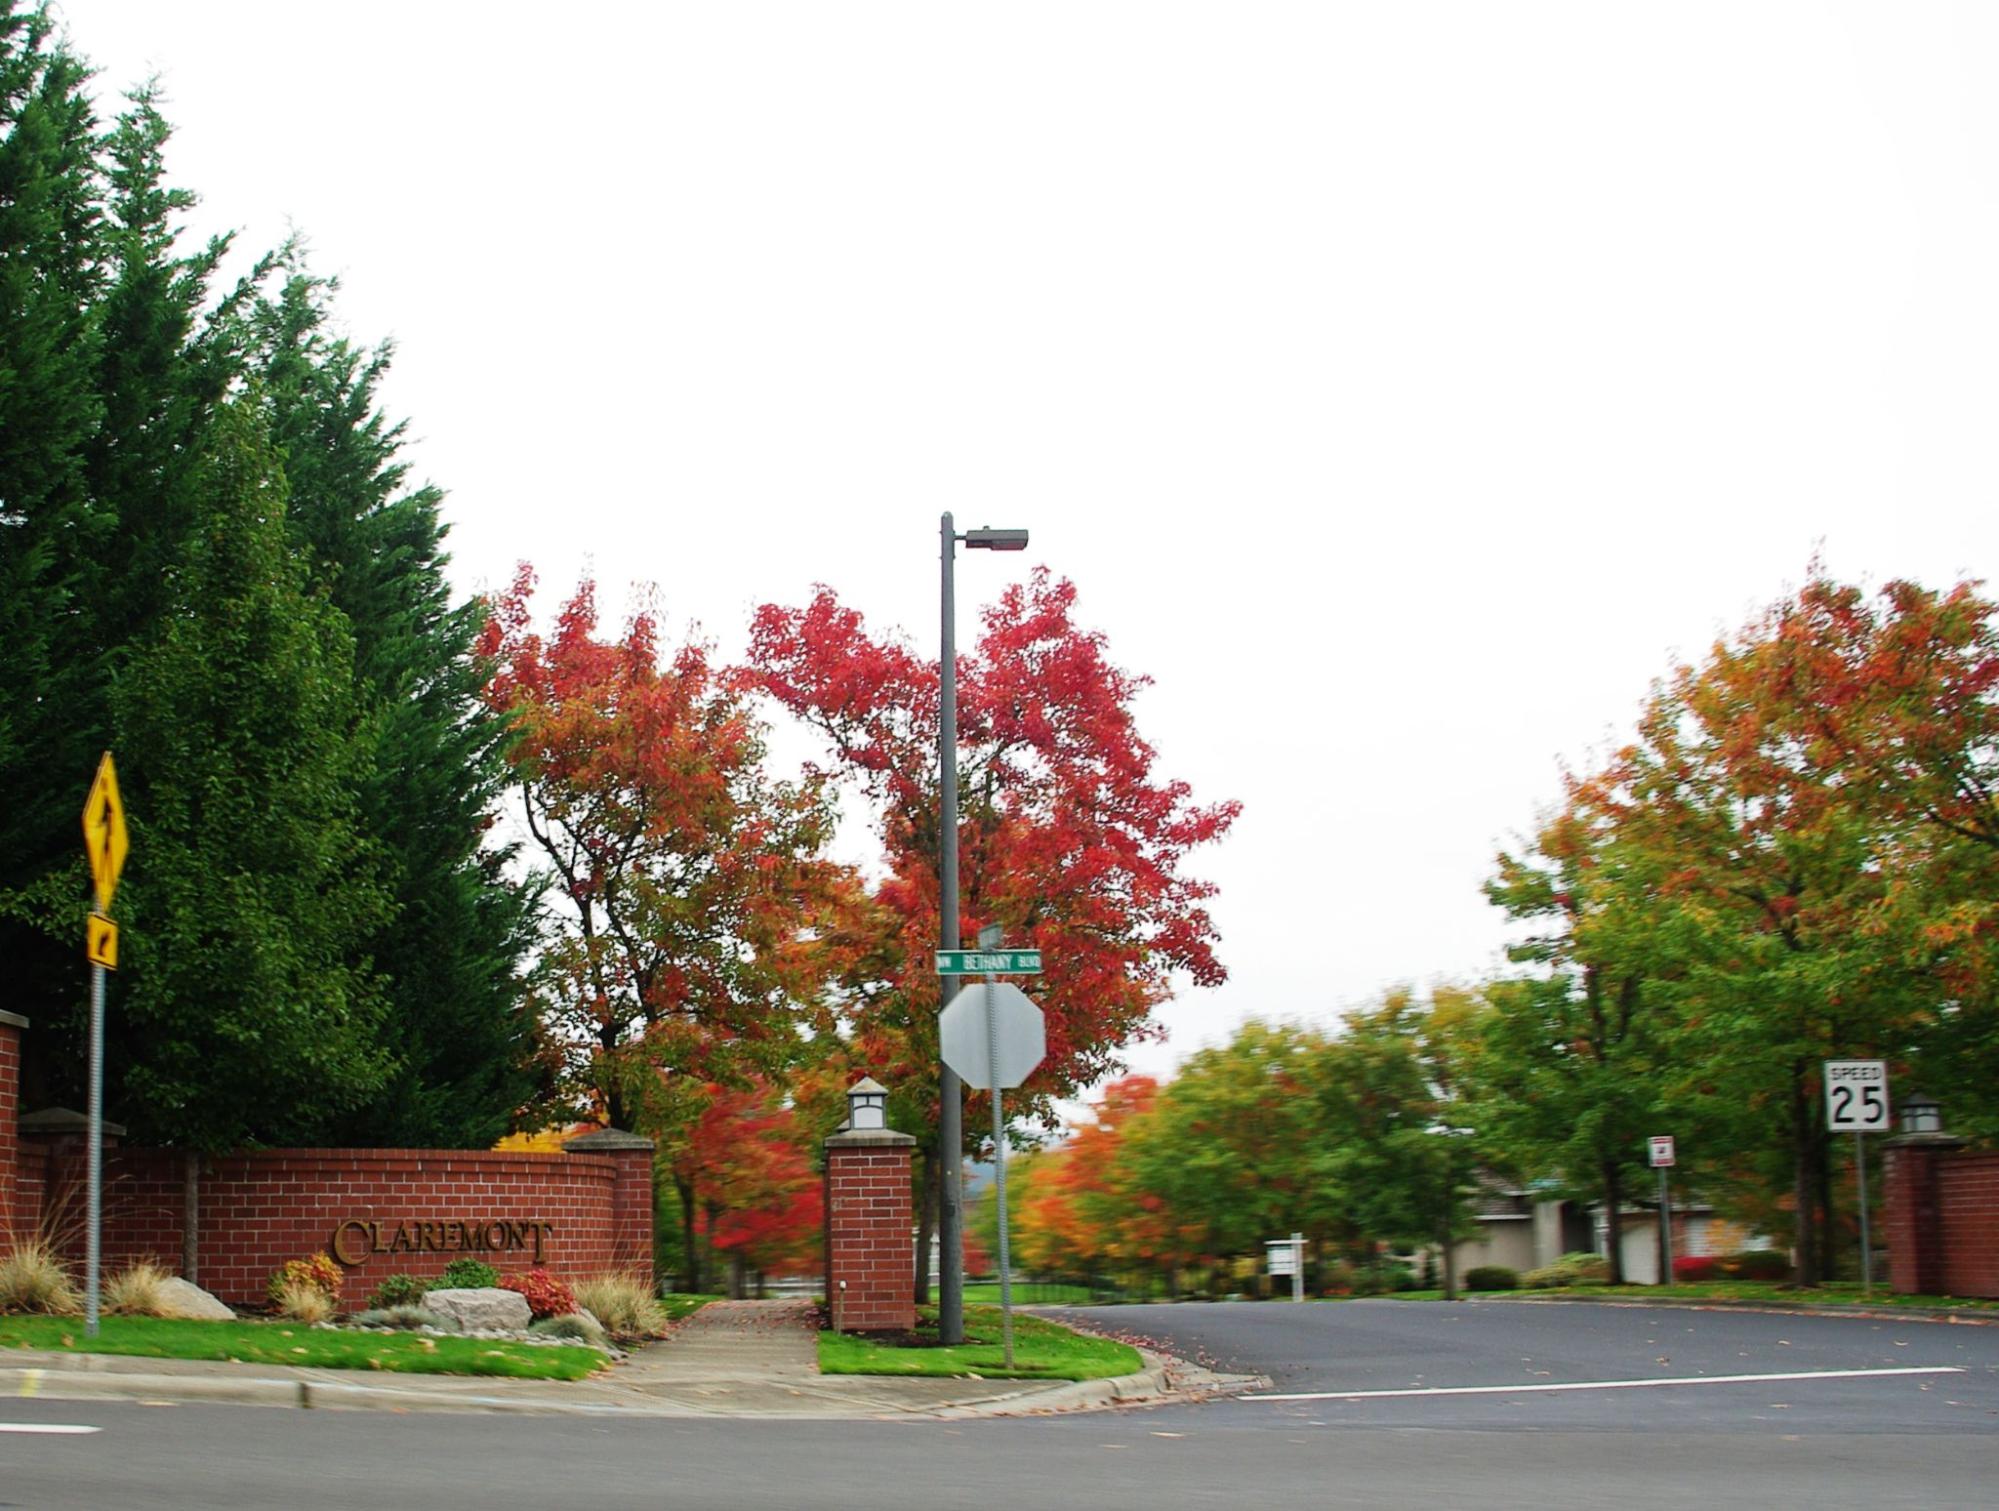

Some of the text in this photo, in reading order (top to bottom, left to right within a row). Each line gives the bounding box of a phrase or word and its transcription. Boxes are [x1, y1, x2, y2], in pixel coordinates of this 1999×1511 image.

[963, 954, 1012, 970] BETHANY
[1831, 1067, 1882, 1081] SPEED
[1831, 1086, 1884, 1123] 25
[334, 1219, 553, 1266] CLAREMONT
